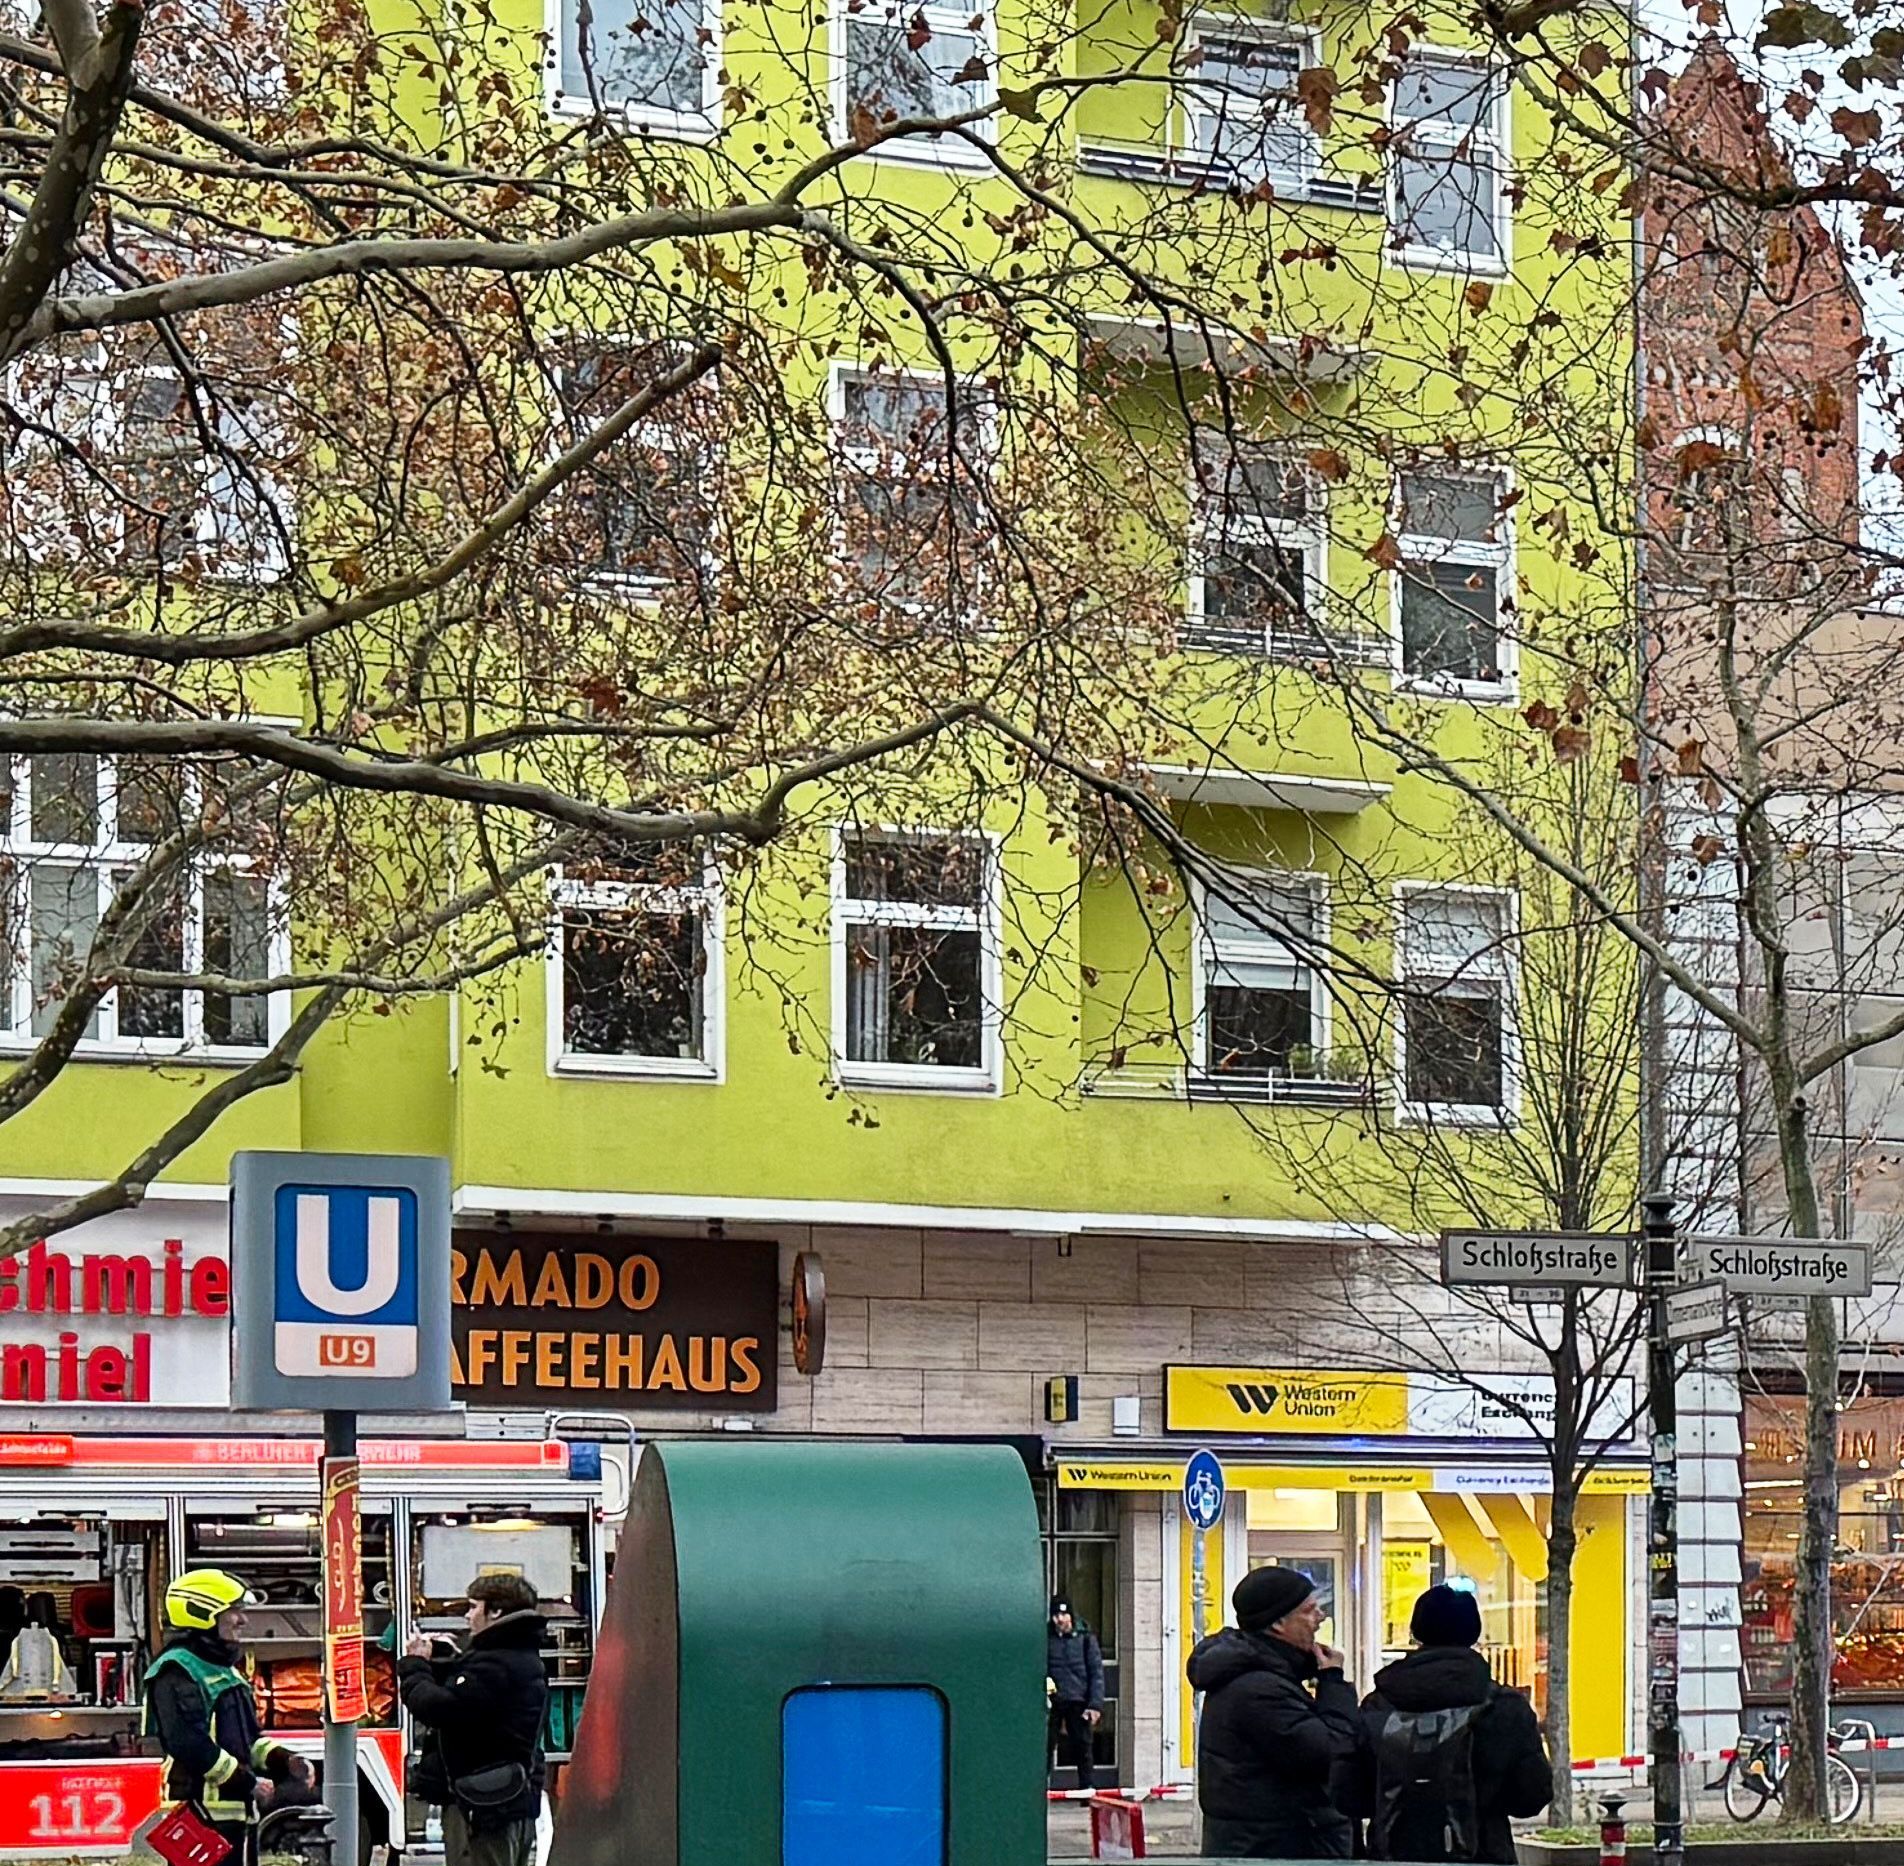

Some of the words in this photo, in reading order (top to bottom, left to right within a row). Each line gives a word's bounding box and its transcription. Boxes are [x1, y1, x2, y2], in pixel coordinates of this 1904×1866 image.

[295, 1194, 400, 1315] U
[1462, 1241, 1618, 1277] Schloßstraße
[1710, 1248, 1848, 1284] Schloßstraße
[327, 1339, 371, 1364] U9
[1285, 1383, 1356, 1402] Western
[1285, 1400, 1336, 1418] Union
[29, 1792, 125, 1837] 112
